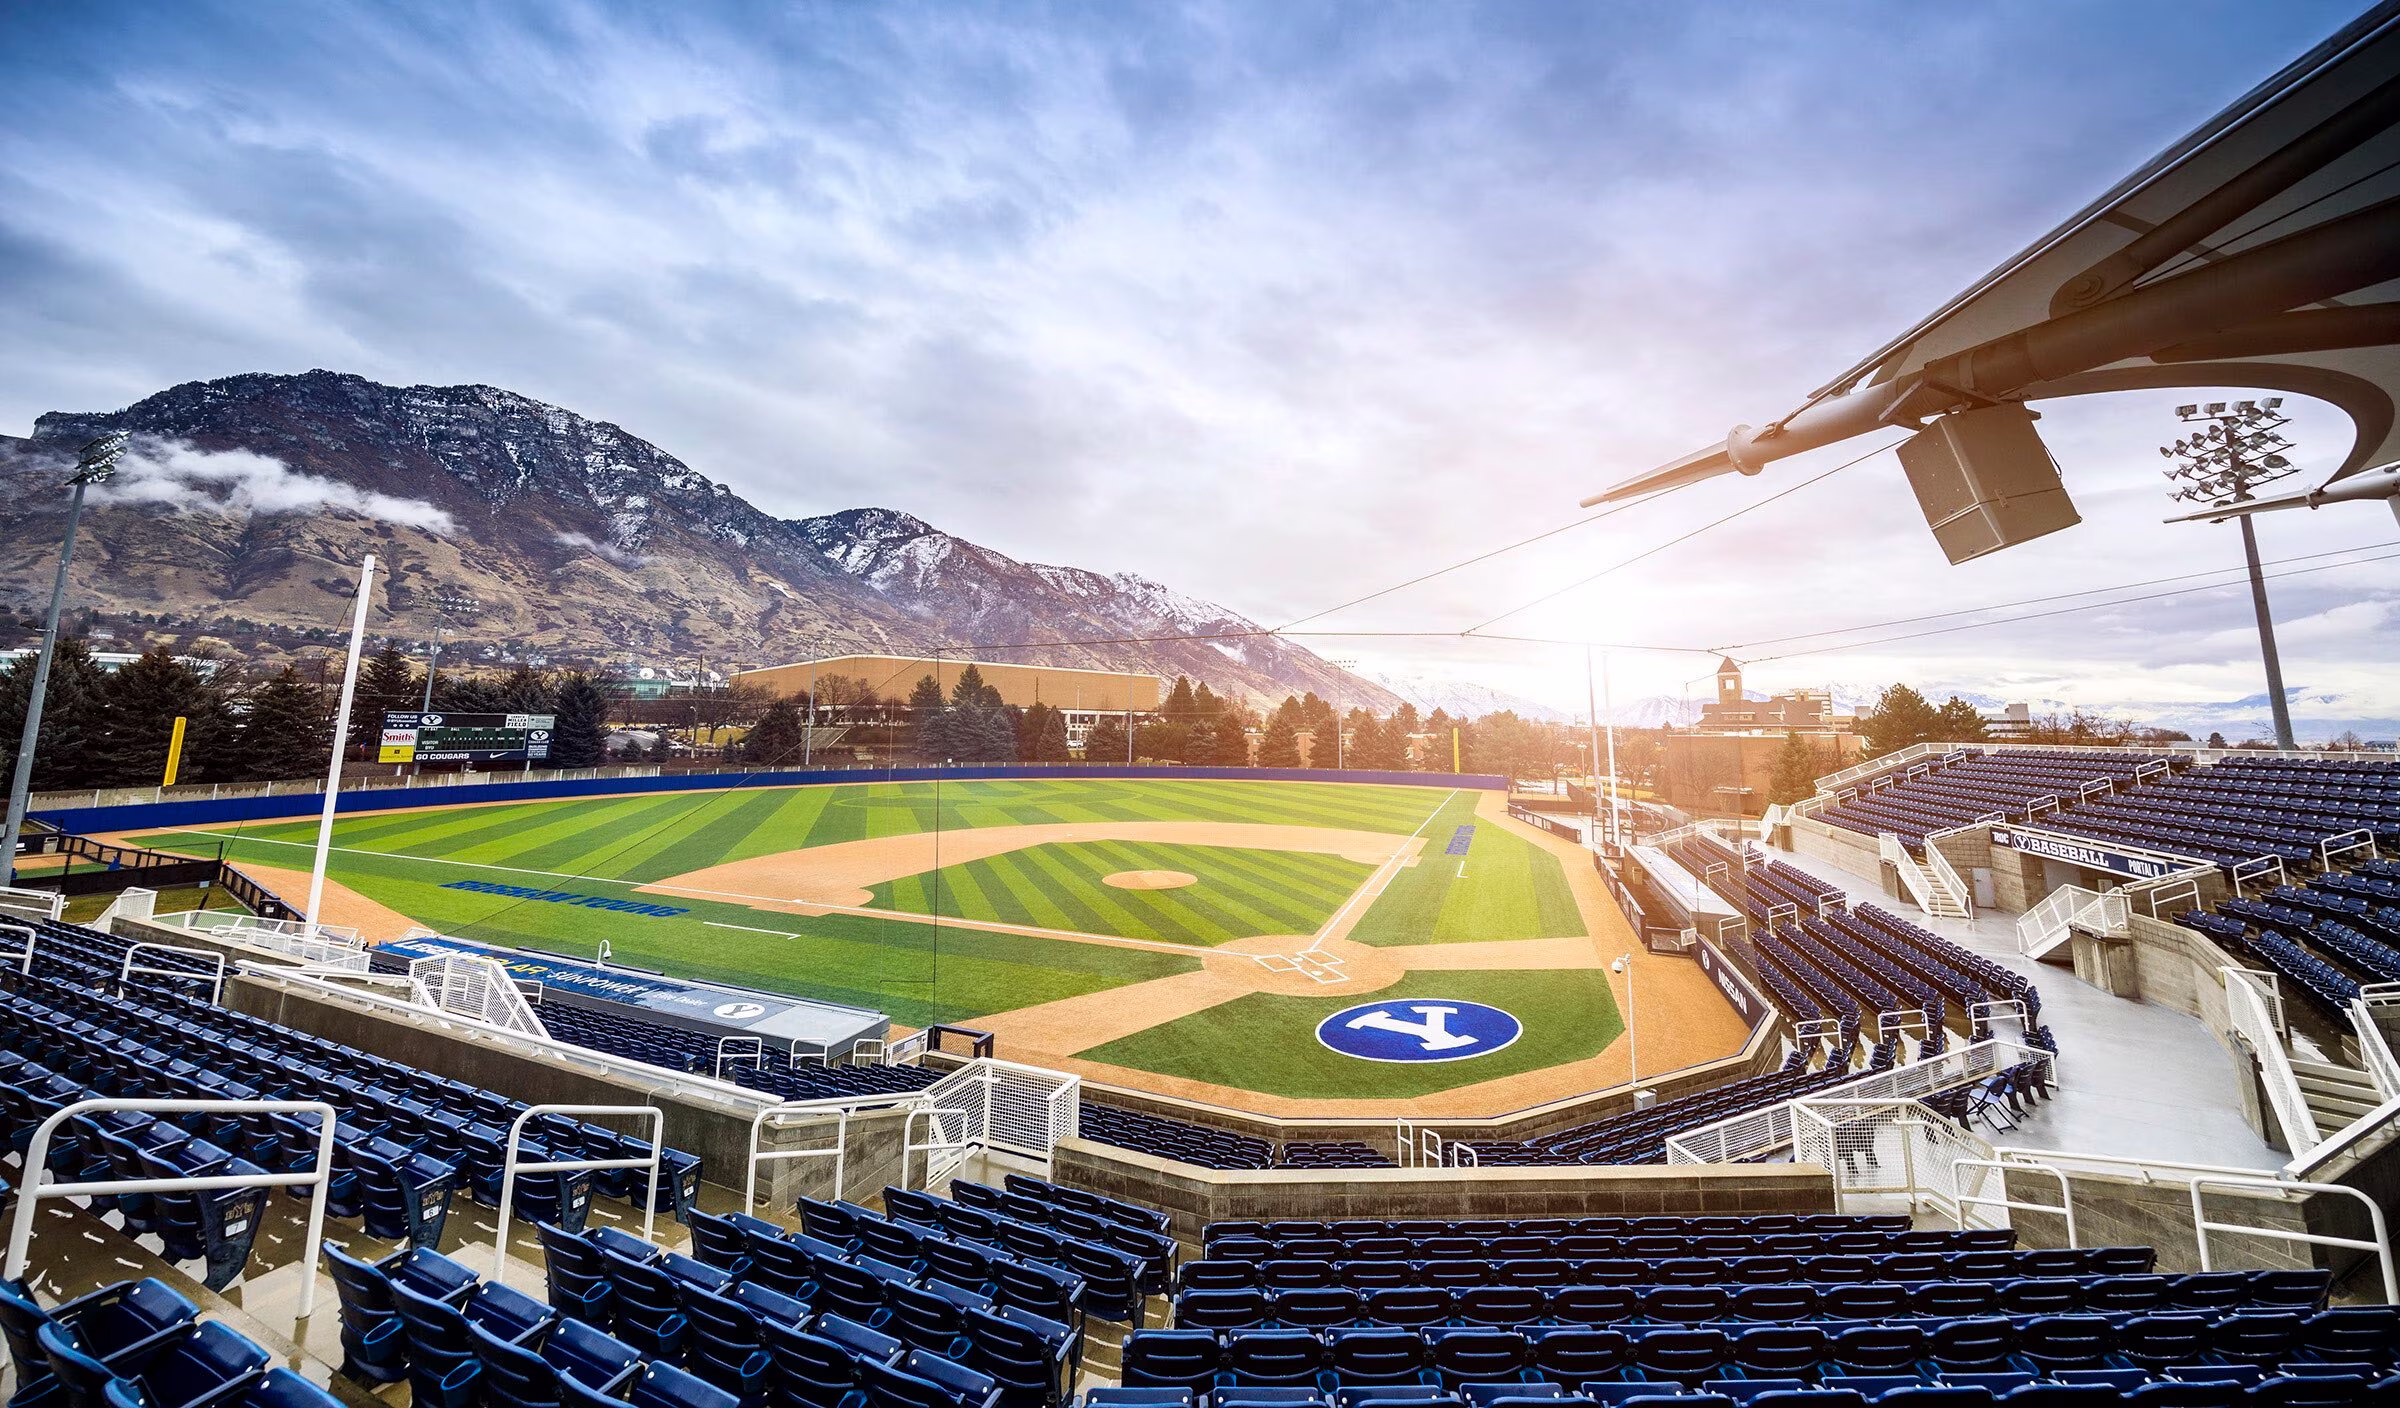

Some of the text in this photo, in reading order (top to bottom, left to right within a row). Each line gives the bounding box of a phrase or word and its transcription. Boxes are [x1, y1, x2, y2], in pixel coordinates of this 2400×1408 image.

[383, 732, 415, 742] Smith's
[2031, 838, 2110, 868] BASEBALL
[2127, 859, 2154, 877] PORTAL
[568, 896, 691, 917] YOUNG
[547, 970, 642, 994] SUNPOWER
[1717, 967, 1748, 1015] NISSAN
